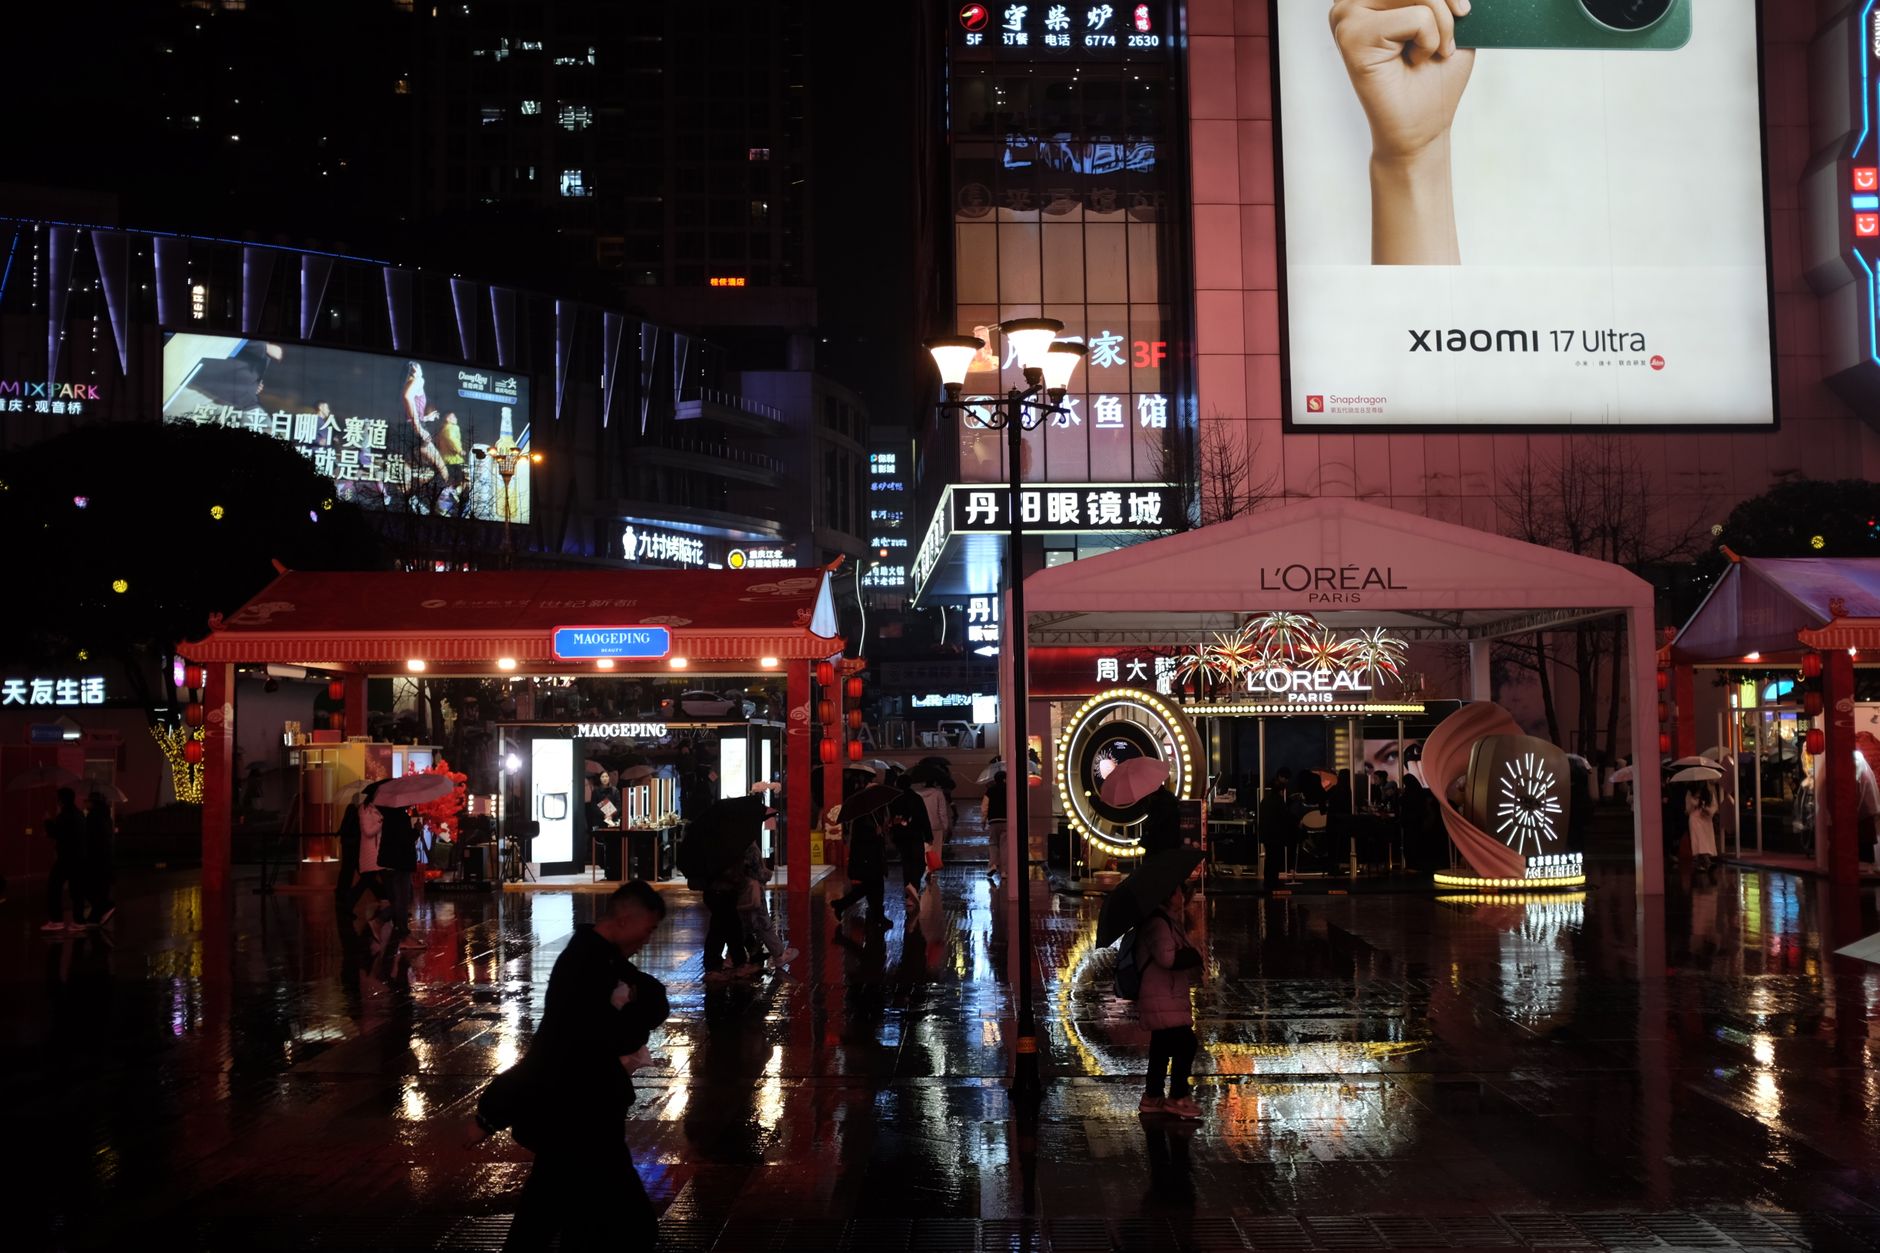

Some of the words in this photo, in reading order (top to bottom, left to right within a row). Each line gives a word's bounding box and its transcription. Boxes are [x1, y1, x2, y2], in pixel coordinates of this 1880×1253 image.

[966, 34, 982, 45] 5F
[1085, 36, 1116, 46] 6774
[1128, 35, 1159, 46] 2630
[1550, 330, 1575, 352] 17
[1582, 328, 1646, 352] Ultra
[1134, 341, 1167, 368] 3F
[1330, 394, 1387, 405] Snapdragon
[639, 531, 704, 565] 九村烤脑花
[1260, 563, 1408, 592] L'ORÉAL
[573, 632, 650, 645] MAOGEPING
[1, 677, 105, 705] 天友生活
[1288, 692, 1334, 703] PARIS
[577, 723, 667, 737] MAOGEPING
